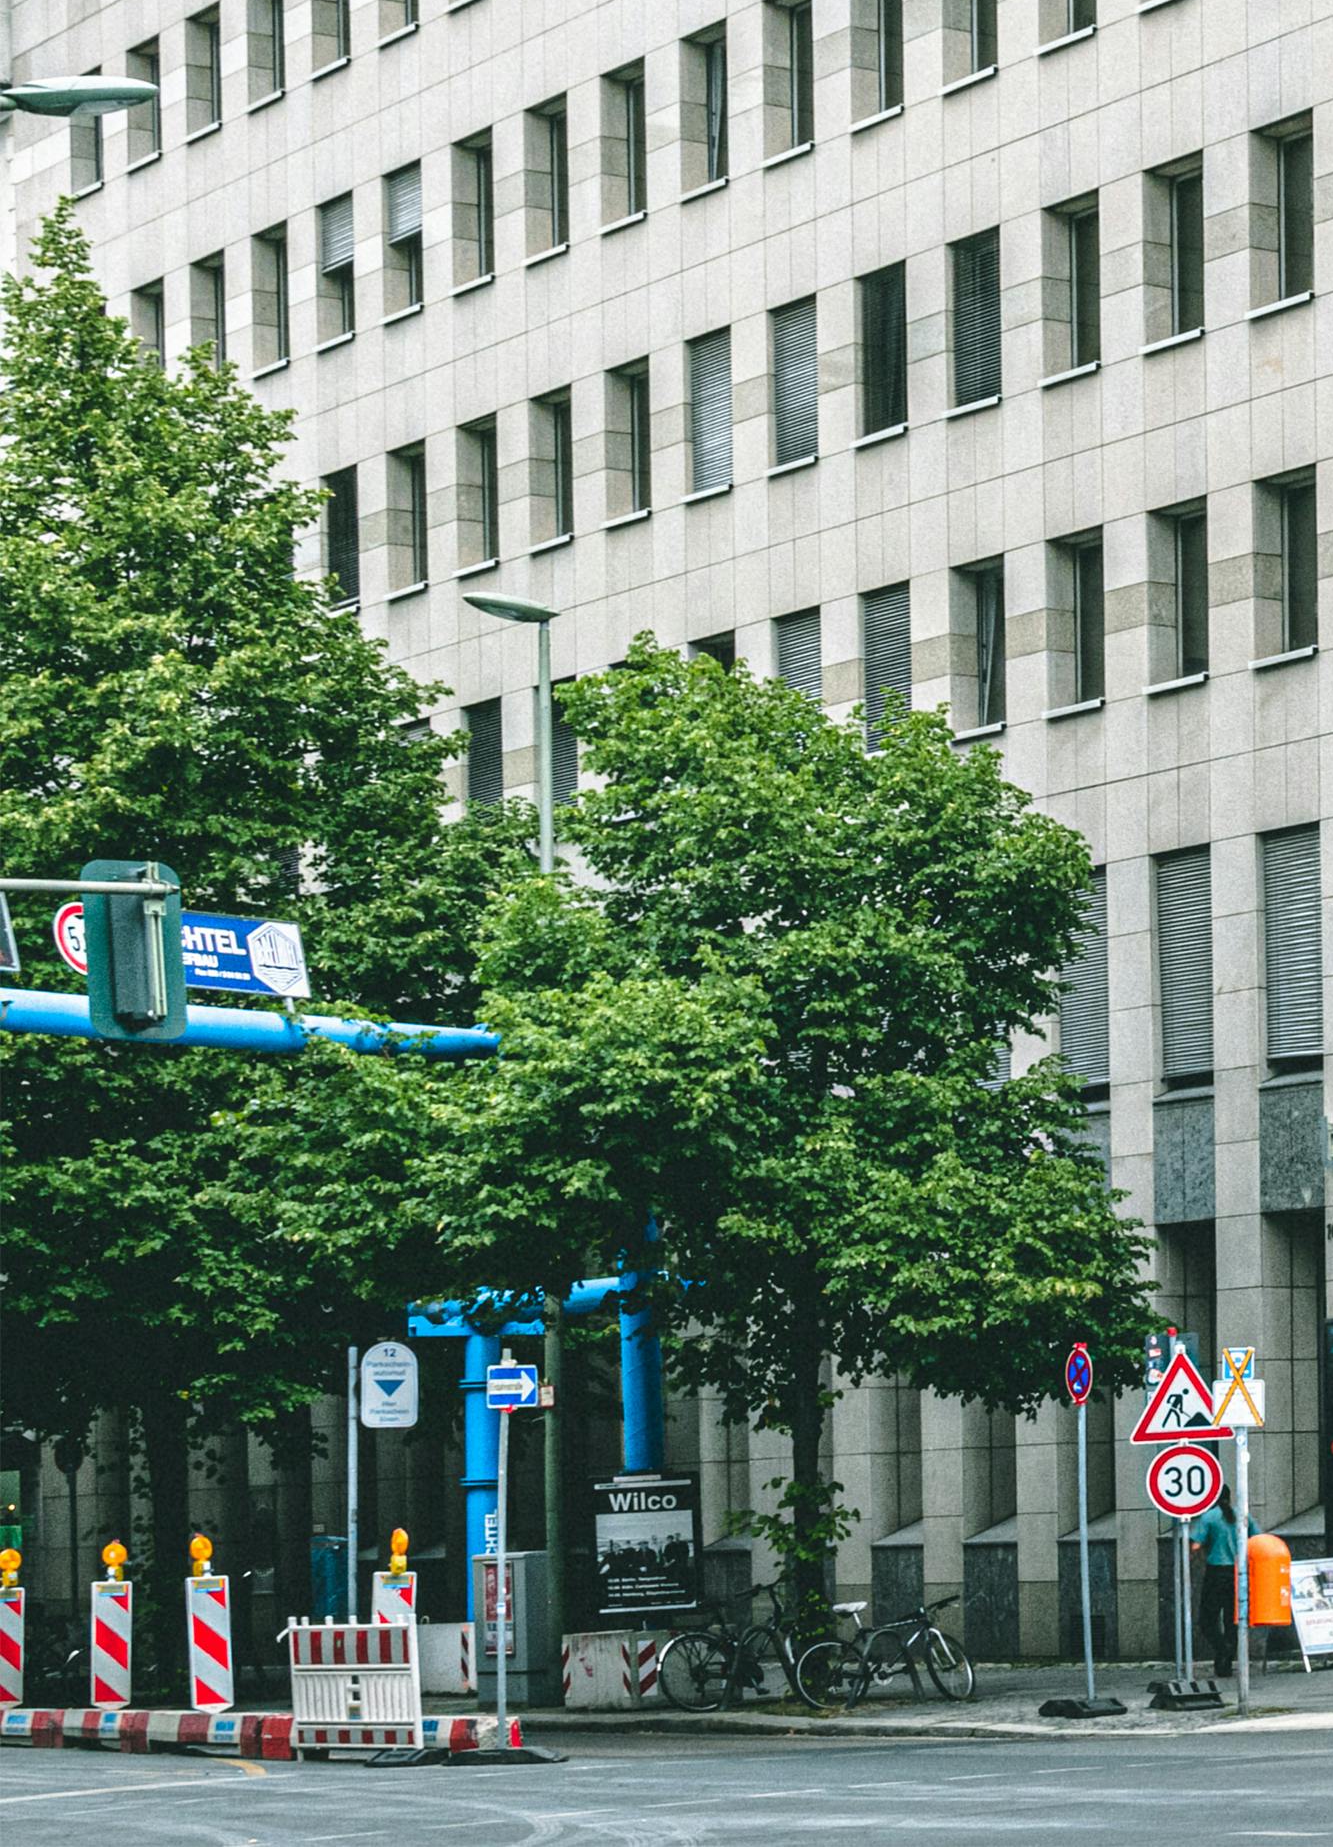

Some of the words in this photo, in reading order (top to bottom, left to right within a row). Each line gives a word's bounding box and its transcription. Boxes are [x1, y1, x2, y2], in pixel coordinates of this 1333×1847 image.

[383, 1348, 396, 1357] 12
[1164, 1465, 1205, 1498] 30
[608, 1492, 677, 1512] Wilco
